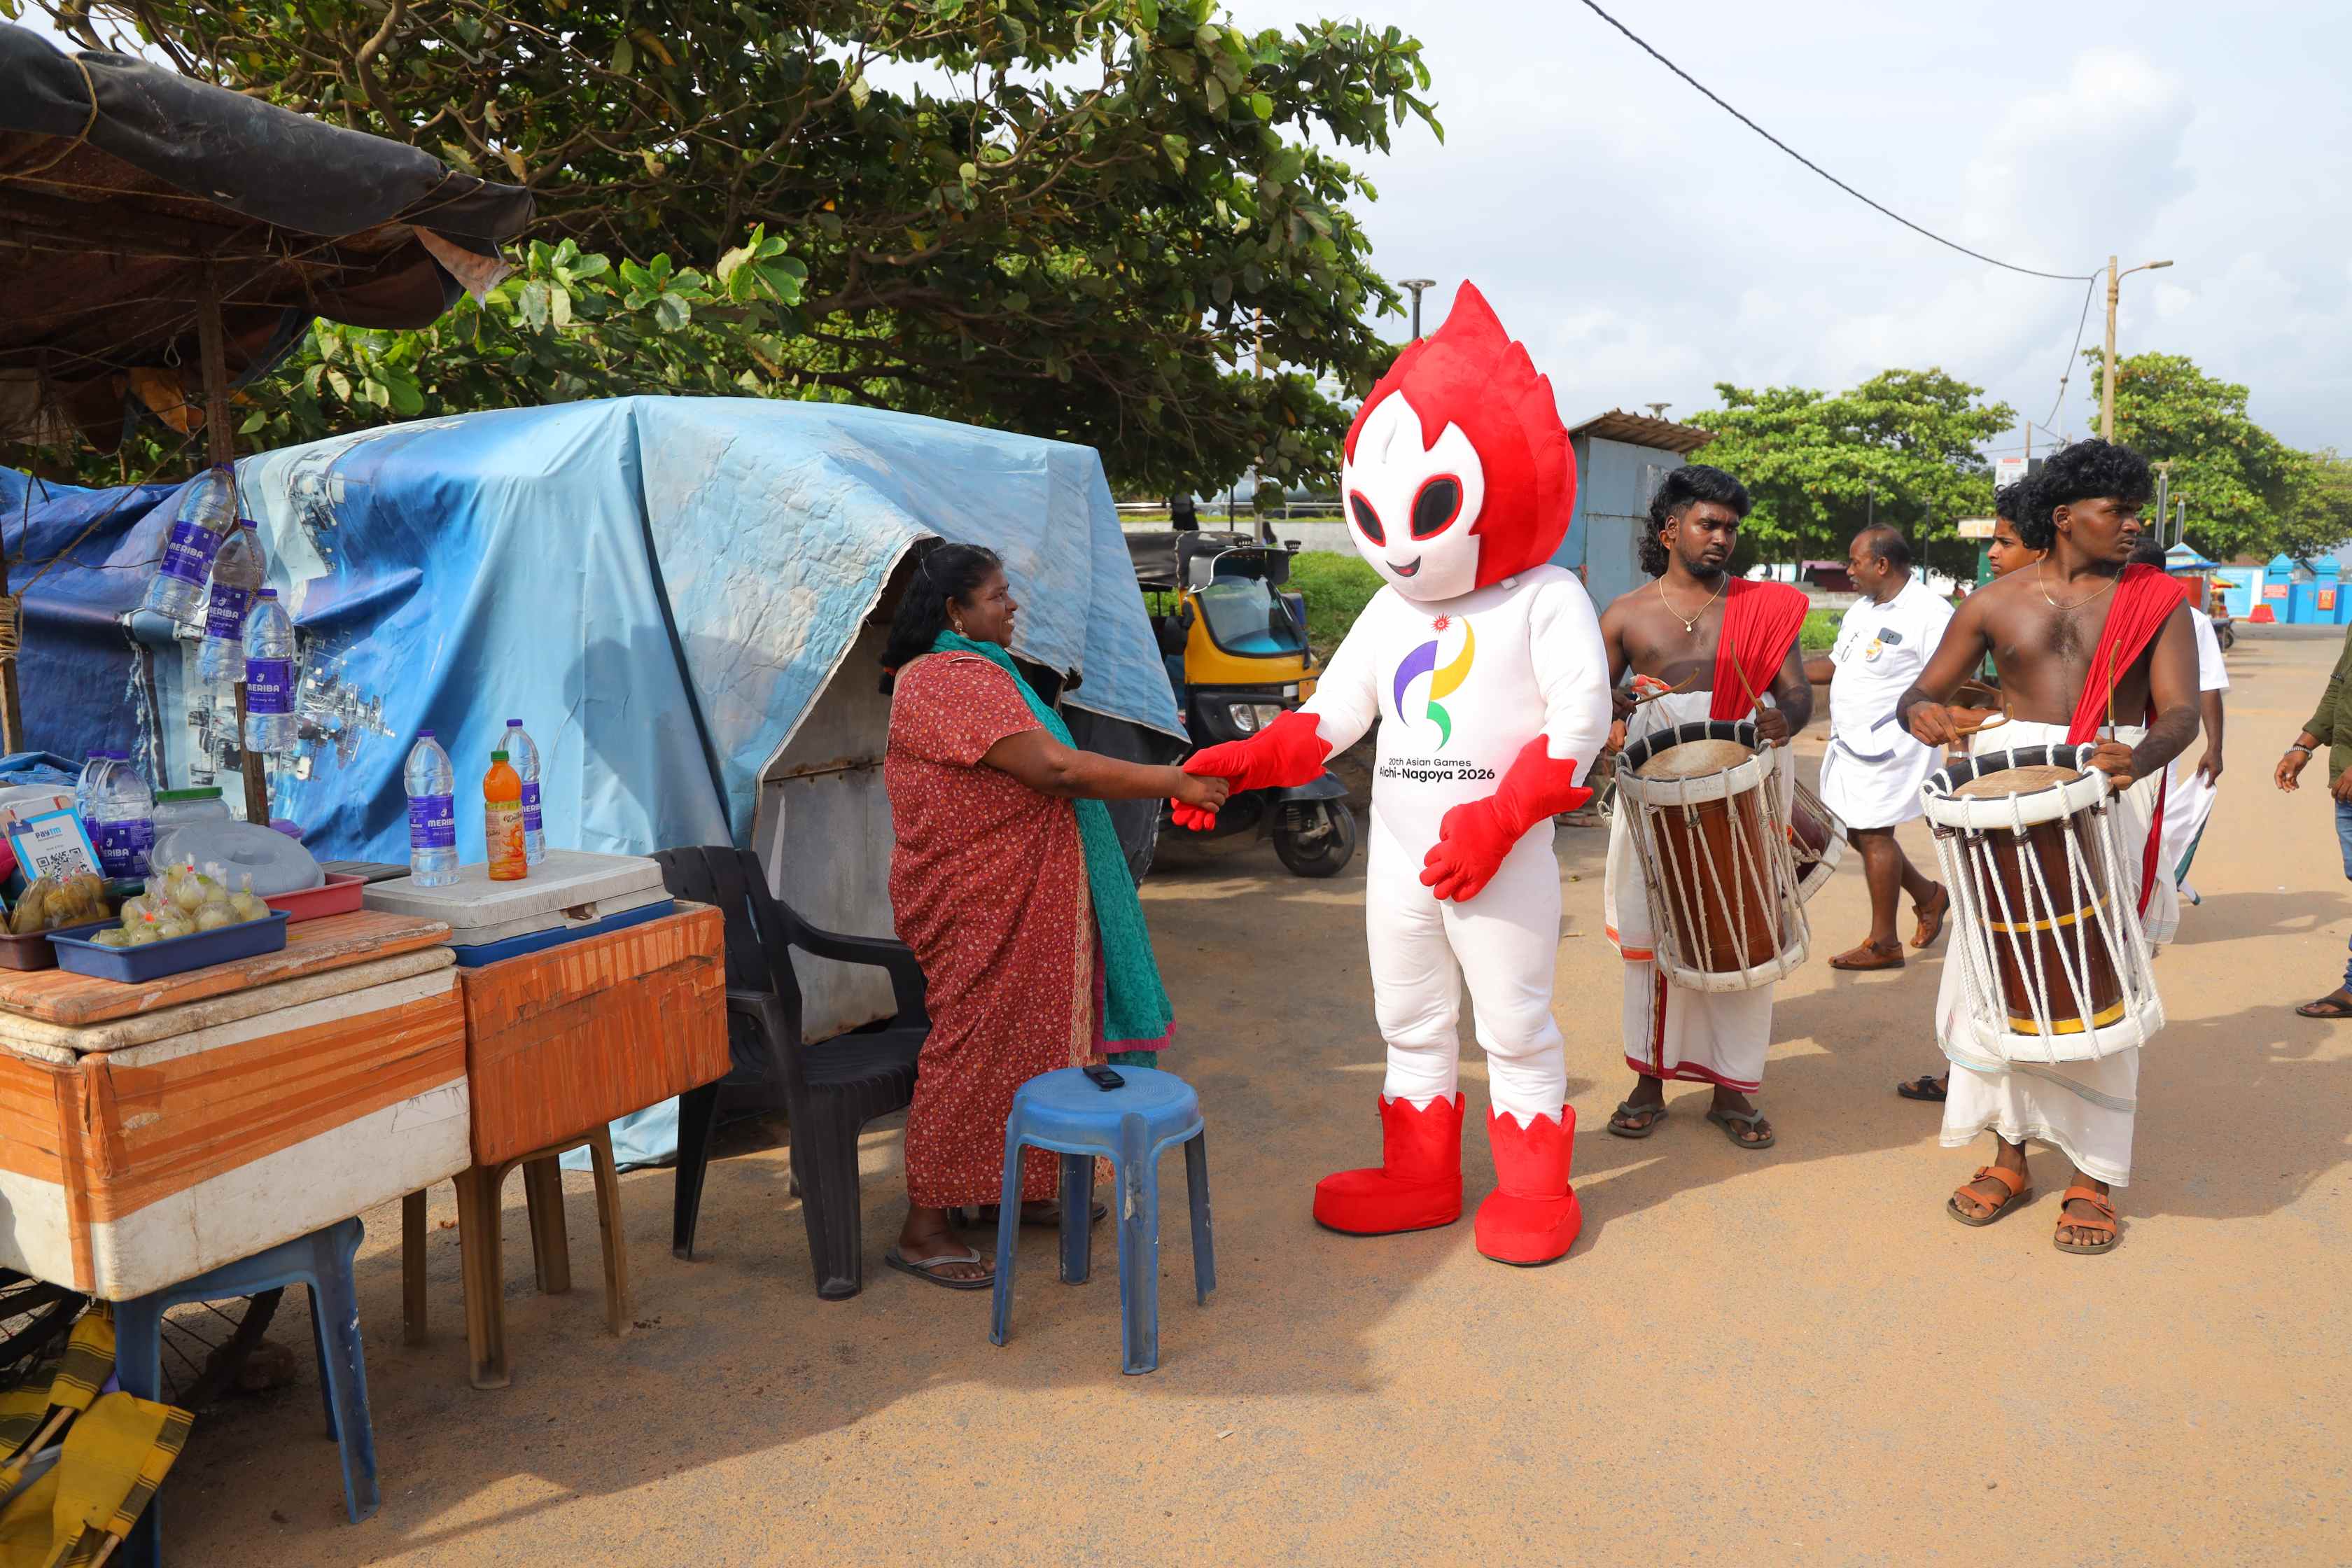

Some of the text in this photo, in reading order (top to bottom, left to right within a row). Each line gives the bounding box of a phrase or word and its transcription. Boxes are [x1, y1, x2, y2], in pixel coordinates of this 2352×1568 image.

[169, 542, 203, 559] MERIBA
[247, 683, 280, 692] MERIBA
[1389, 757, 1472, 767] 20th Asian Games
[1379, 766, 1496, 783] Aichi-Nagoya 2026
[103, 848, 130, 858] ERIBA
